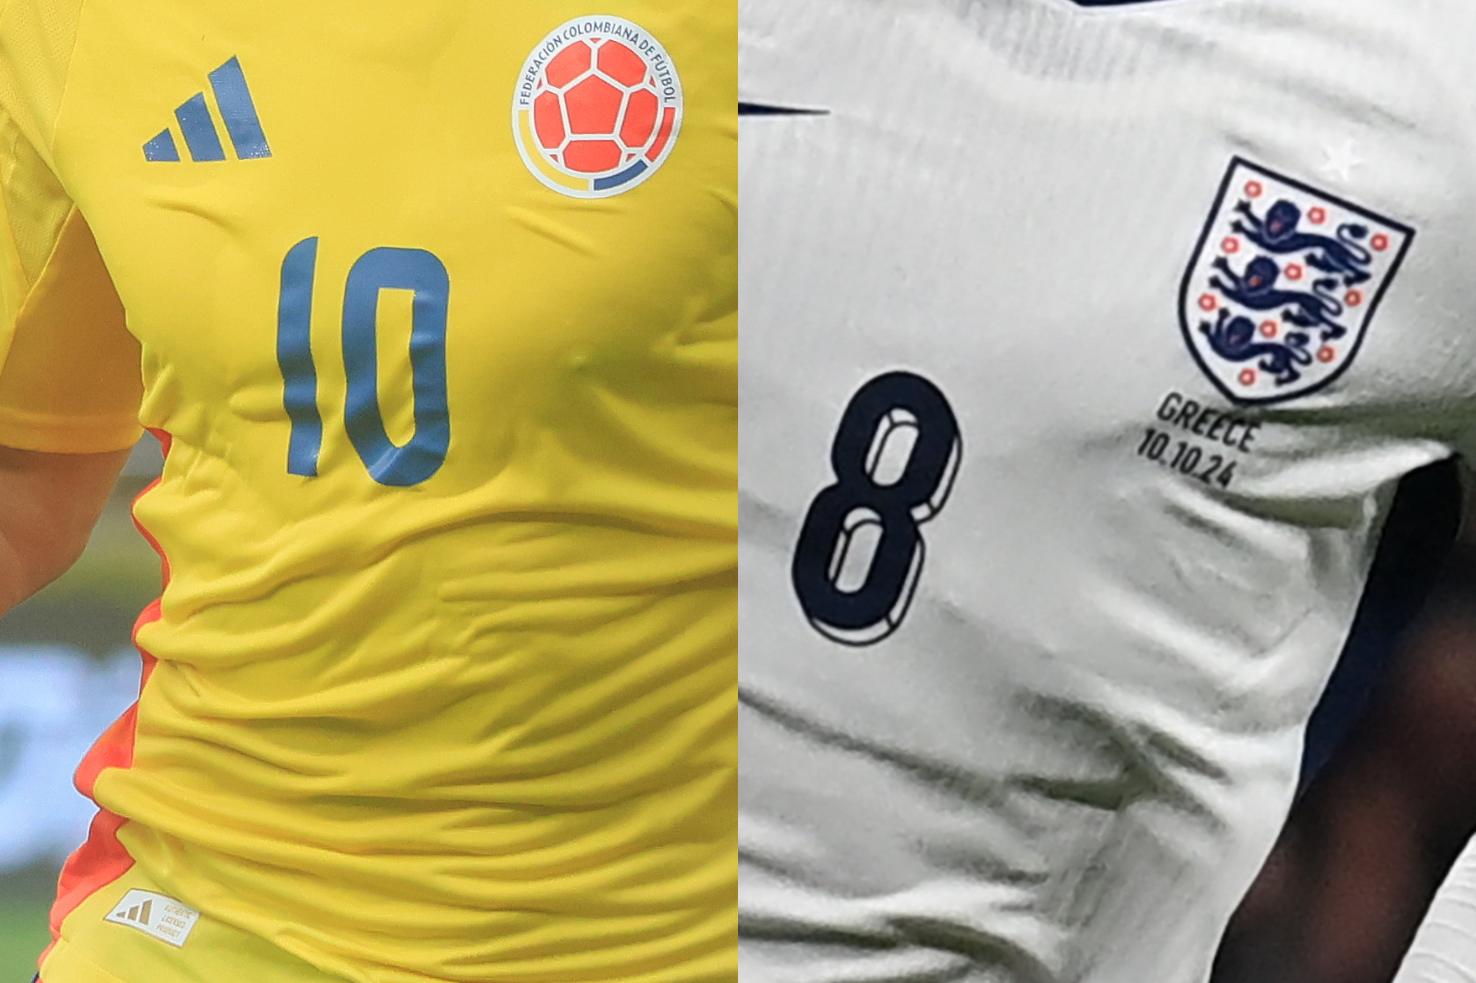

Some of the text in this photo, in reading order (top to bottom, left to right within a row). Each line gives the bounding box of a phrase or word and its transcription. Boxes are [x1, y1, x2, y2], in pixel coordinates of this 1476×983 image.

[563, 21, 638, 46] COLOMBIANA
[639, 39, 656, 56] DE
[650, 53, 677, 104] FÚTBOL
[276, 235, 451, 487] 10
[1137, 428, 1237, 489] 10.10.24
[1156, 391, 1262, 454] GREECE
[791, 370, 963, 647] 8
